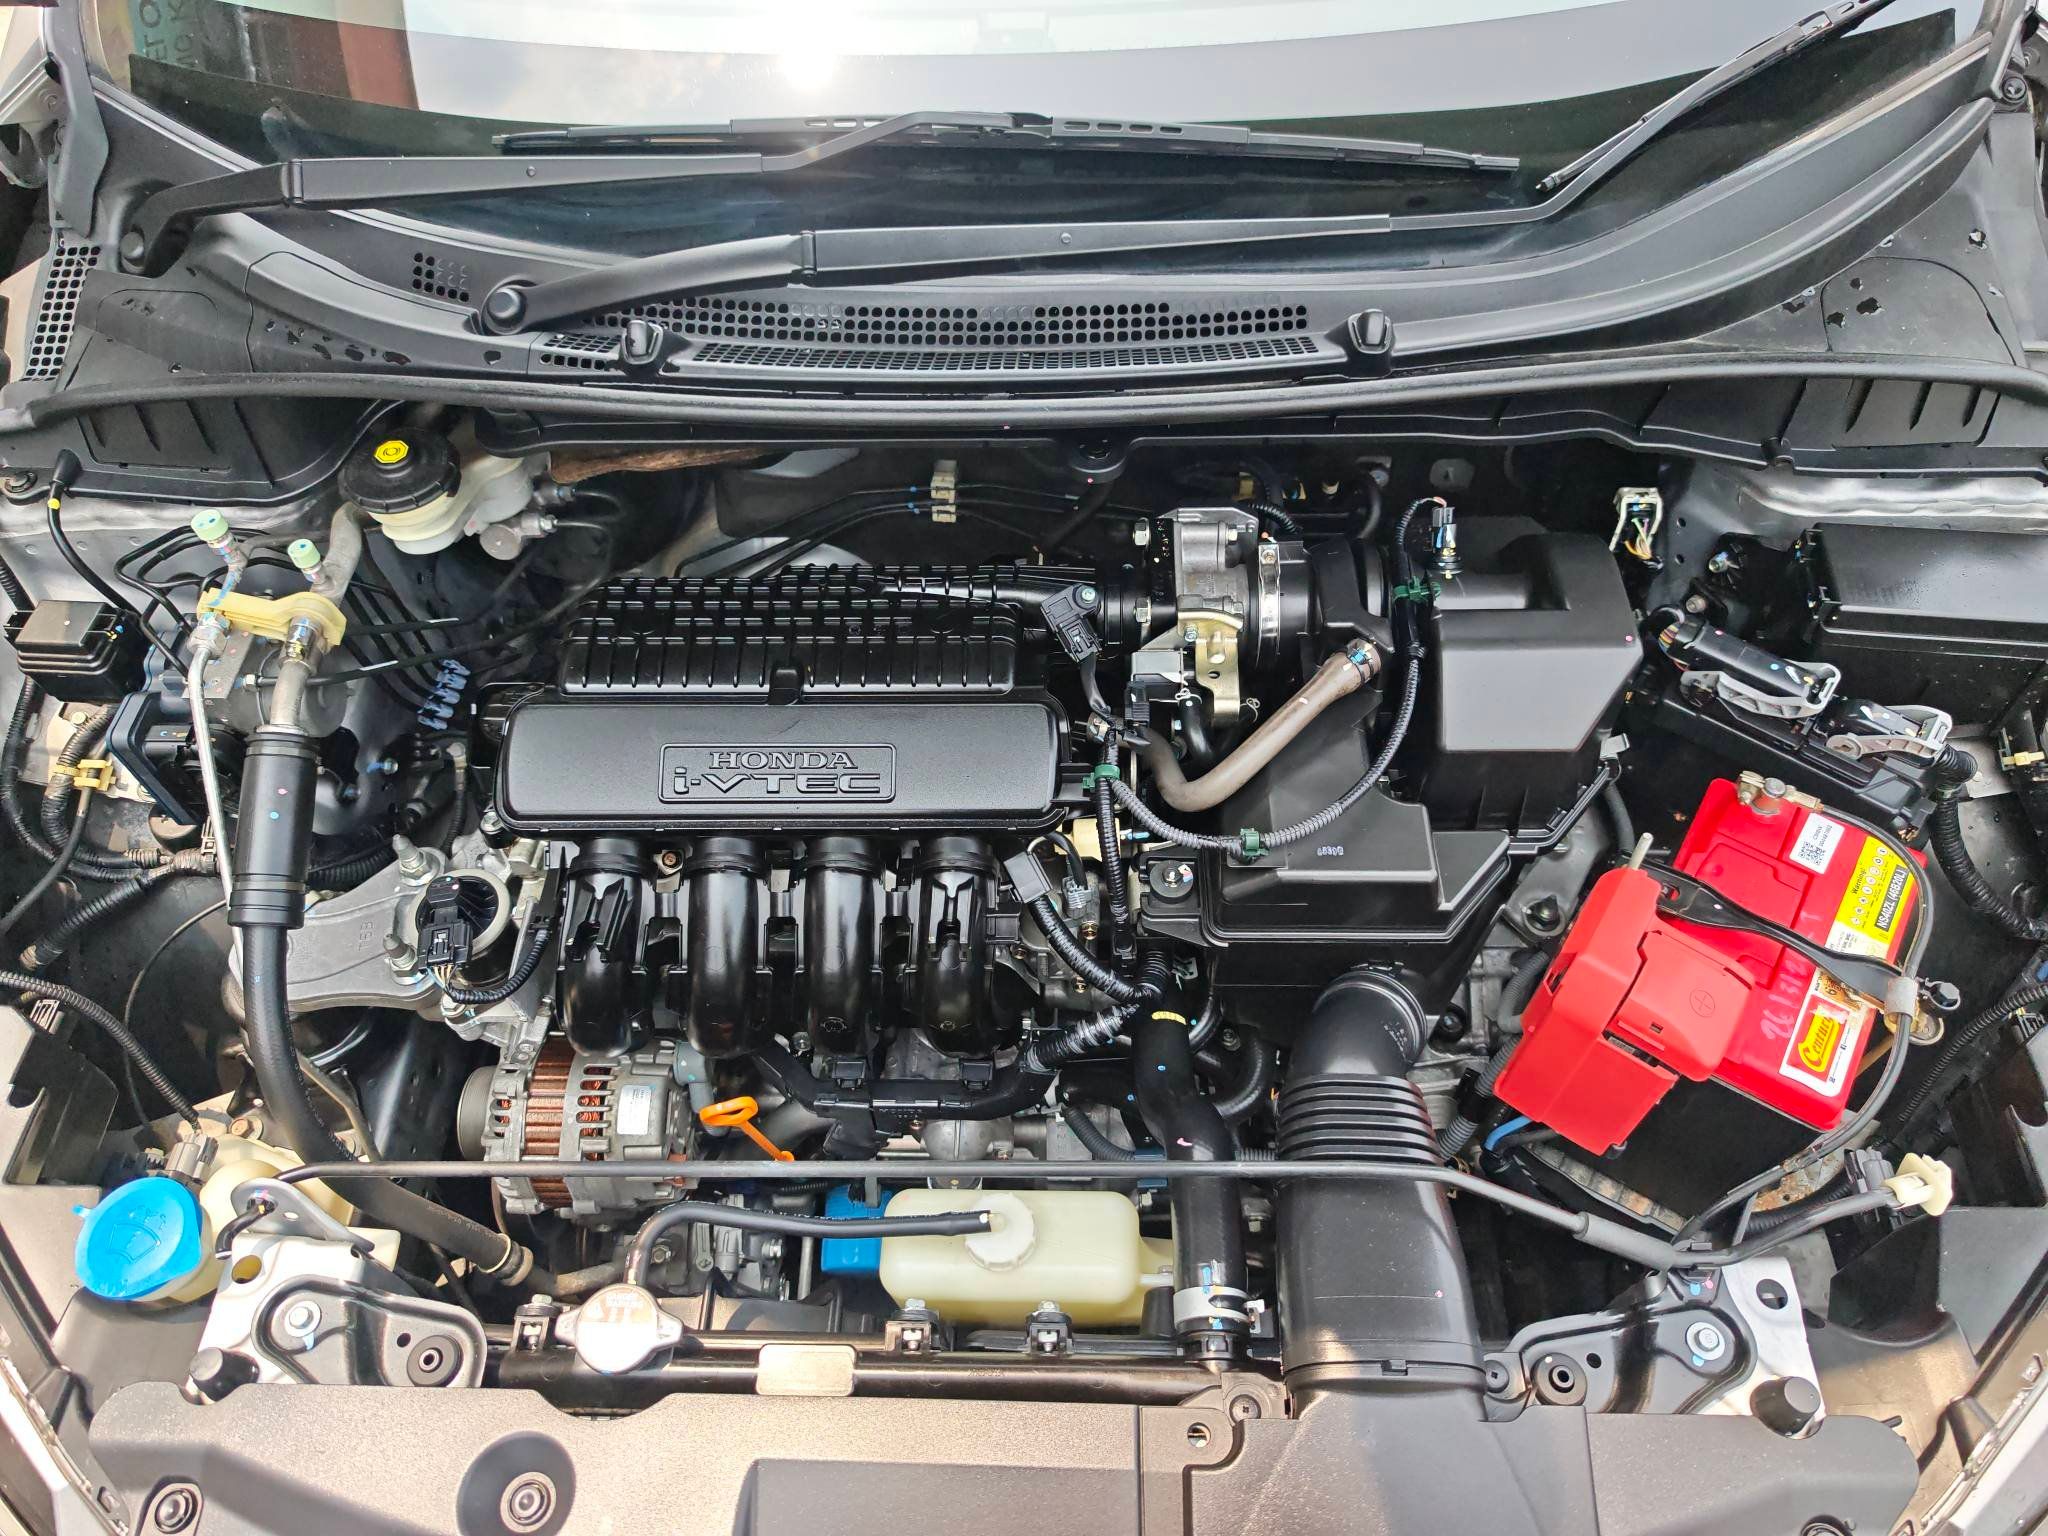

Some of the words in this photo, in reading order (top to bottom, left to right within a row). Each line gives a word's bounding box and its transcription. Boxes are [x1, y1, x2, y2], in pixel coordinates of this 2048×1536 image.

[709, 751, 858, 770] HONDA
[673, 766, 881, 794] i-VTEC
[1852, 868, 1867, 895] Warning!
[1877, 901, 1896, 929] NS40ZL
